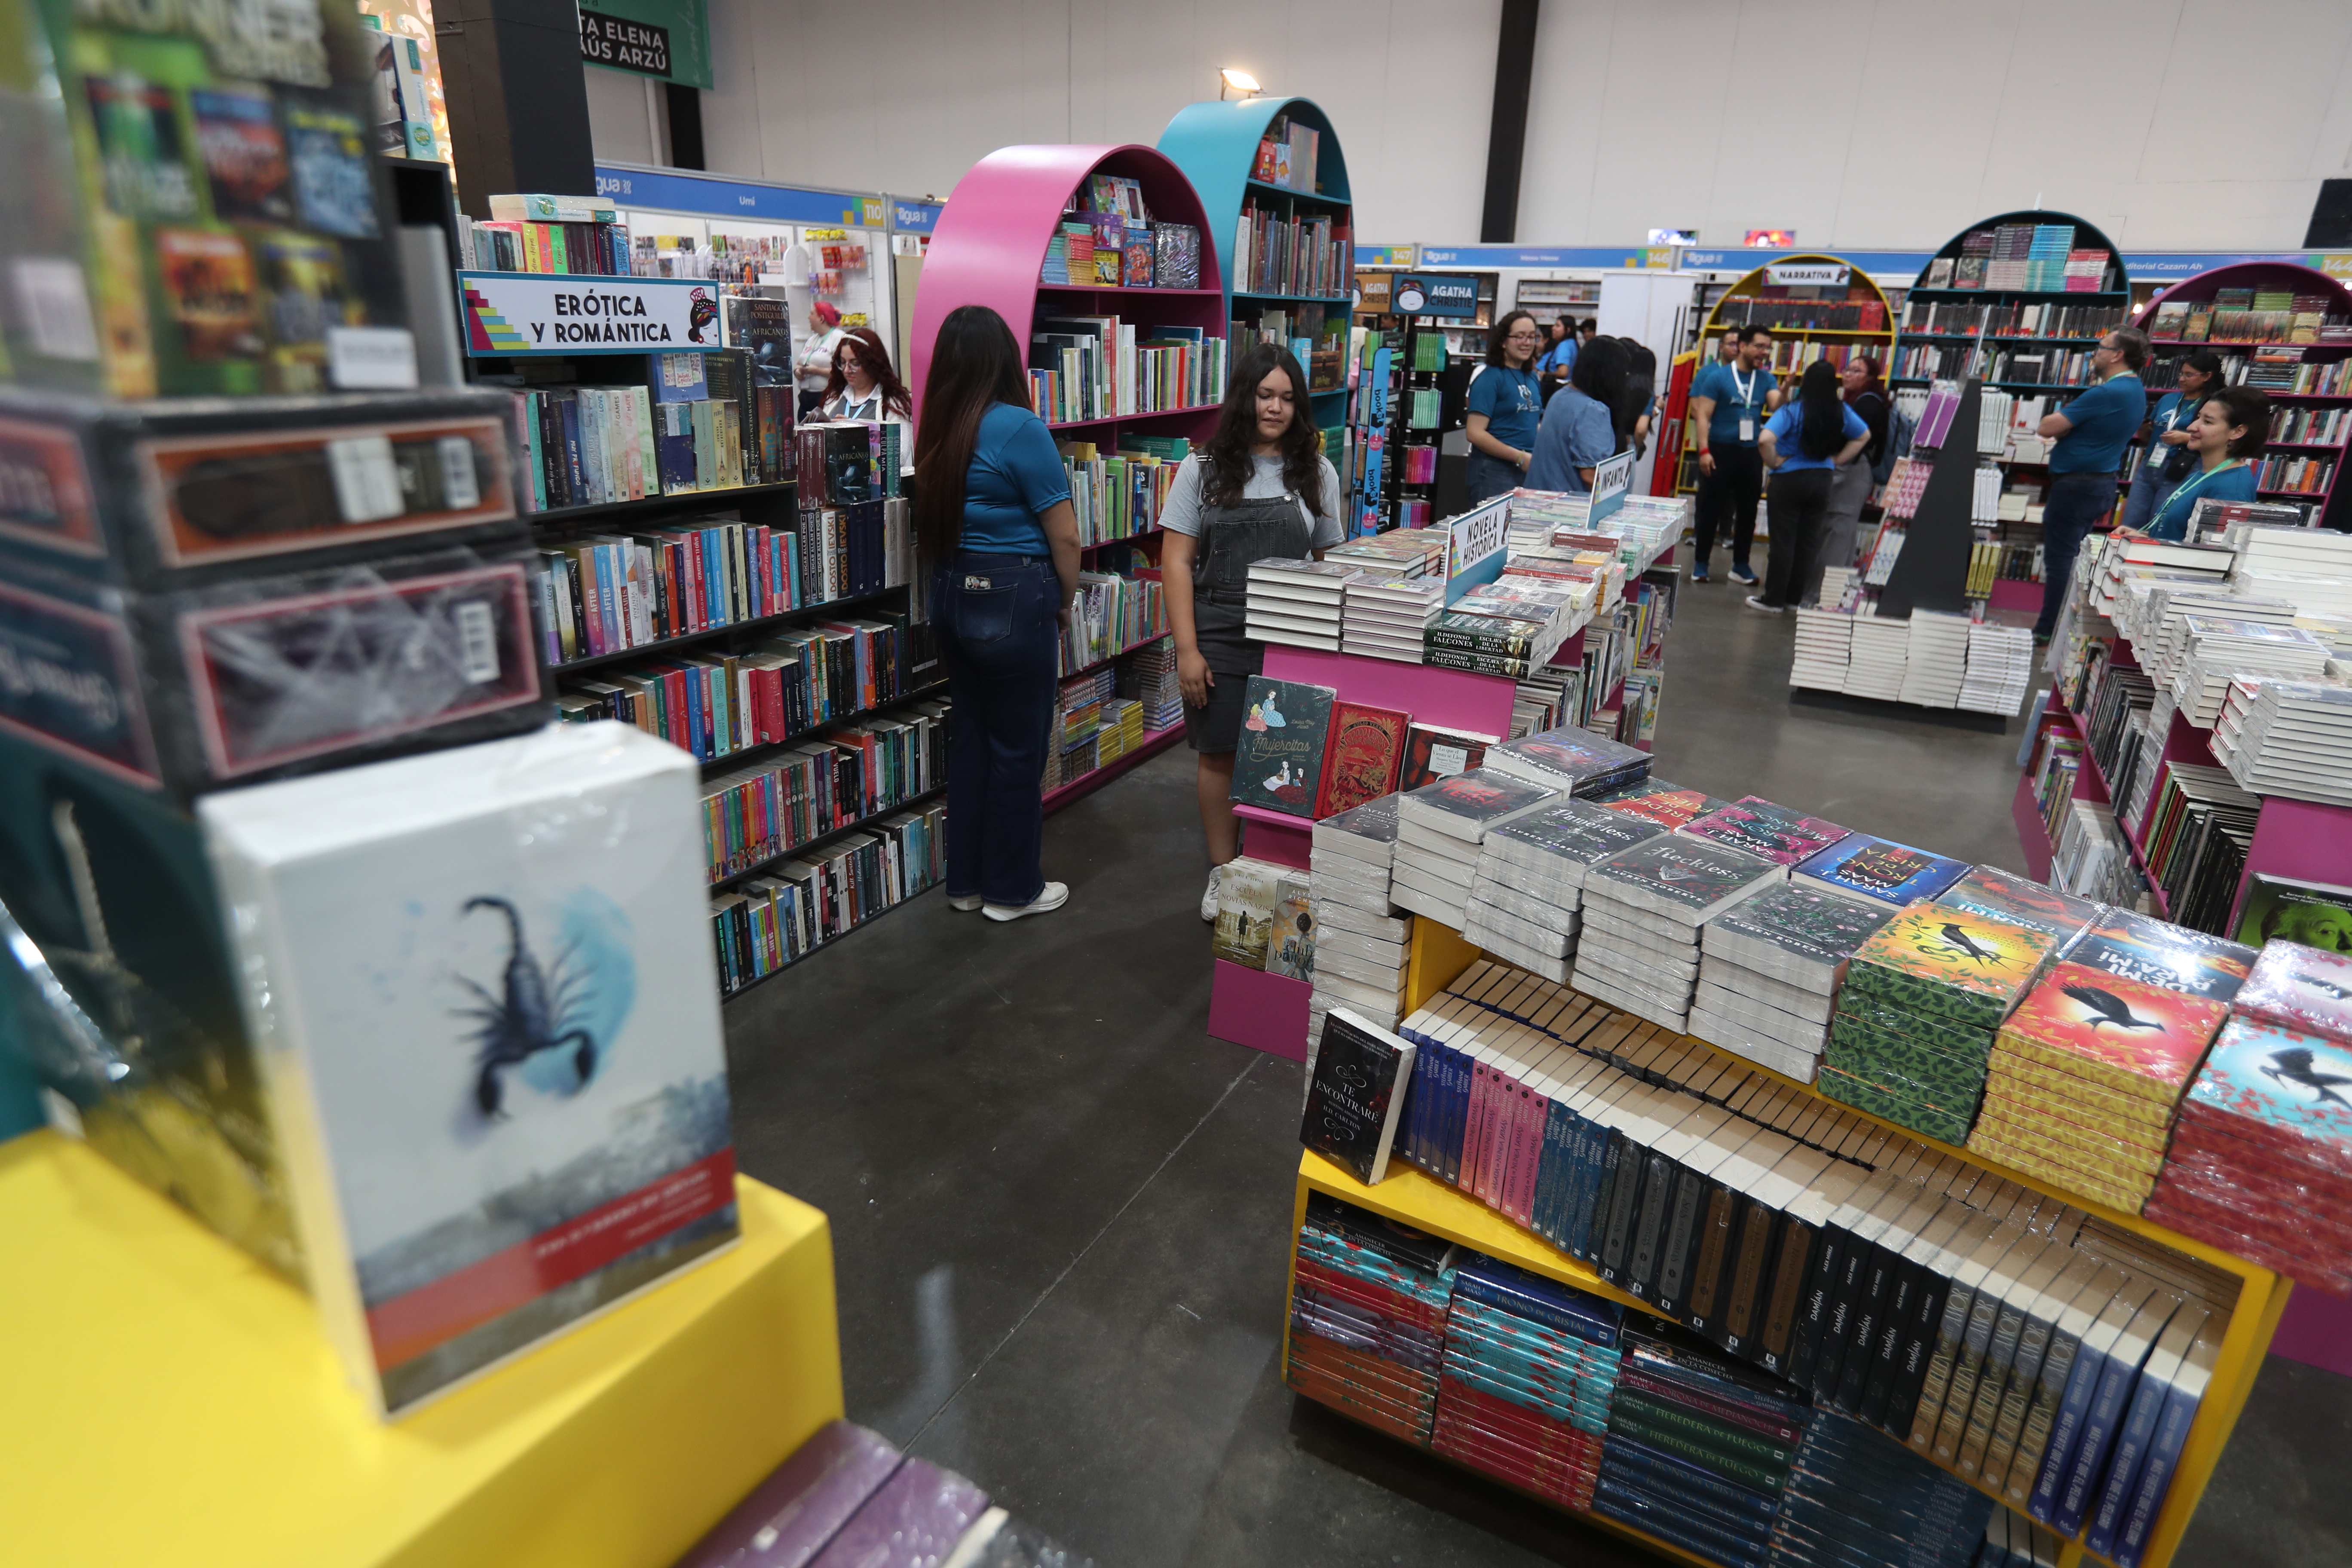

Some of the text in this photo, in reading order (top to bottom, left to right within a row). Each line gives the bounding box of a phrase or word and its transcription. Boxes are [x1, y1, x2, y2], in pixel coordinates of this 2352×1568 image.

[606, 22, 664, 50] ELENA
[619, 46, 666, 70] ARZÚ
[739, 196, 755, 206] Umi
[865, 202, 882, 220] 110
[1393, 251, 1410, 260] 147
[1779, 271, 1832, 280] NARRATIVA
[2122, 263, 2155, 271] ditorial
[1365, 283, 1388, 294] AGATHA
[1432, 285, 1472, 298] AGATHA
[554, 288, 648, 317] ERÓTICA
[754, 303, 783, 312] SANTIAGO
[1430, 296, 1472, 308] CHRISTIE
[530, 317, 672, 343] Y ROMÁNTICA
[752, 328, 789, 336] AFRICANUS
[1375, 389, 1383, 423] booket
[1368, 469, 1377, 502] booket
[1602, 465, 1625, 490] INFANTIL
[1467, 511, 1498, 544] NOVELA
[1463, 532, 1497, 567] HISTÓRICA
[589, 588, 597, 612] AFTER
[603, 588, 612, 610] AFTER
[1433, 636, 1473, 647] FALCONES
[1437, 632, 1470, 640] ILDEFONSO
[1435, 652, 1468, 661] ILDEFONSO
[1476, 645, 1503, 653] LIBERTAD
[1432, 656, 1470, 668] FALCONES
[1473, 666, 1501, 674] LIBERTAD
[1254, 737, 1311, 756] Mujercitas
[1496, 745, 1535, 766] MARCUS
[1478, 767, 1558, 794] JOANA MARCUS
[1538, 763, 1574, 779] JOANA
[1648, 788, 1714, 815] FUEGO
[1660, 799, 1673, 807] DE
[1550, 808, 1635, 841] Powerless
[1725, 816, 1802, 845] CORONA
[1758, 821, 1772, 830] DE
[1505, 826, 1593, 859] LAUREN ROBERTS
[1719, 833, 1777, 856] SARAH
[1725, 829, 1773, 847] MAAS
[1643, 846, 1743, 881] Reckless
[1856, 845, 1938, 874] CRISTAL
[1874, 860, 1888, 869] DE
[1837, 856, 1919, 886] TRONO
[1840, 869, 1893, 888] MAAS
[1231, 884, 1263, 898] ESCUELA
[1605, 867, 1703, 903] LAUREN ROBERTS
[1835, 875, 1899, 898] SARAH
[1222, 894, 1269, 912] NOVIAS NAZIS
[1289, 895, 1319, 906] RICHMA
[1724, 919, 1834, 958] LAUREN ROBERTS
[1343, 1082, 1355, 1096] TE
[1316, 1079, 1379, 1123] ENCONTRARÉ
[1335, 1112, 1361, 1131] CARLTON
[1354, 1232, 1386, 1250] AMANECER
[1365, 1243, 1393, 1258] COSECHA
[1464, 1286, 1482, 1297] MAAS
[1496, 1293, 1533, 1314] TRONO
[1547, 1311, 1587, 1333] CRISTAL
[1686, 1354, 1727, 1372] AMANECER
[1699, 1366, 1734, 1381] COSECHA
[1629, 1380, 1649, 1390] MAAS
[1657, 1385, 1776, 1432] CORONA MEDIANOCHE
[1656, 1409, 1711, 1434] HEREDERA
[1727, 1433, 1767, 1453] FUEGO
[1649, 1431, 1703, 1458] HEREDERA
[1719, 1457, 1758, 1477] FUEGO
